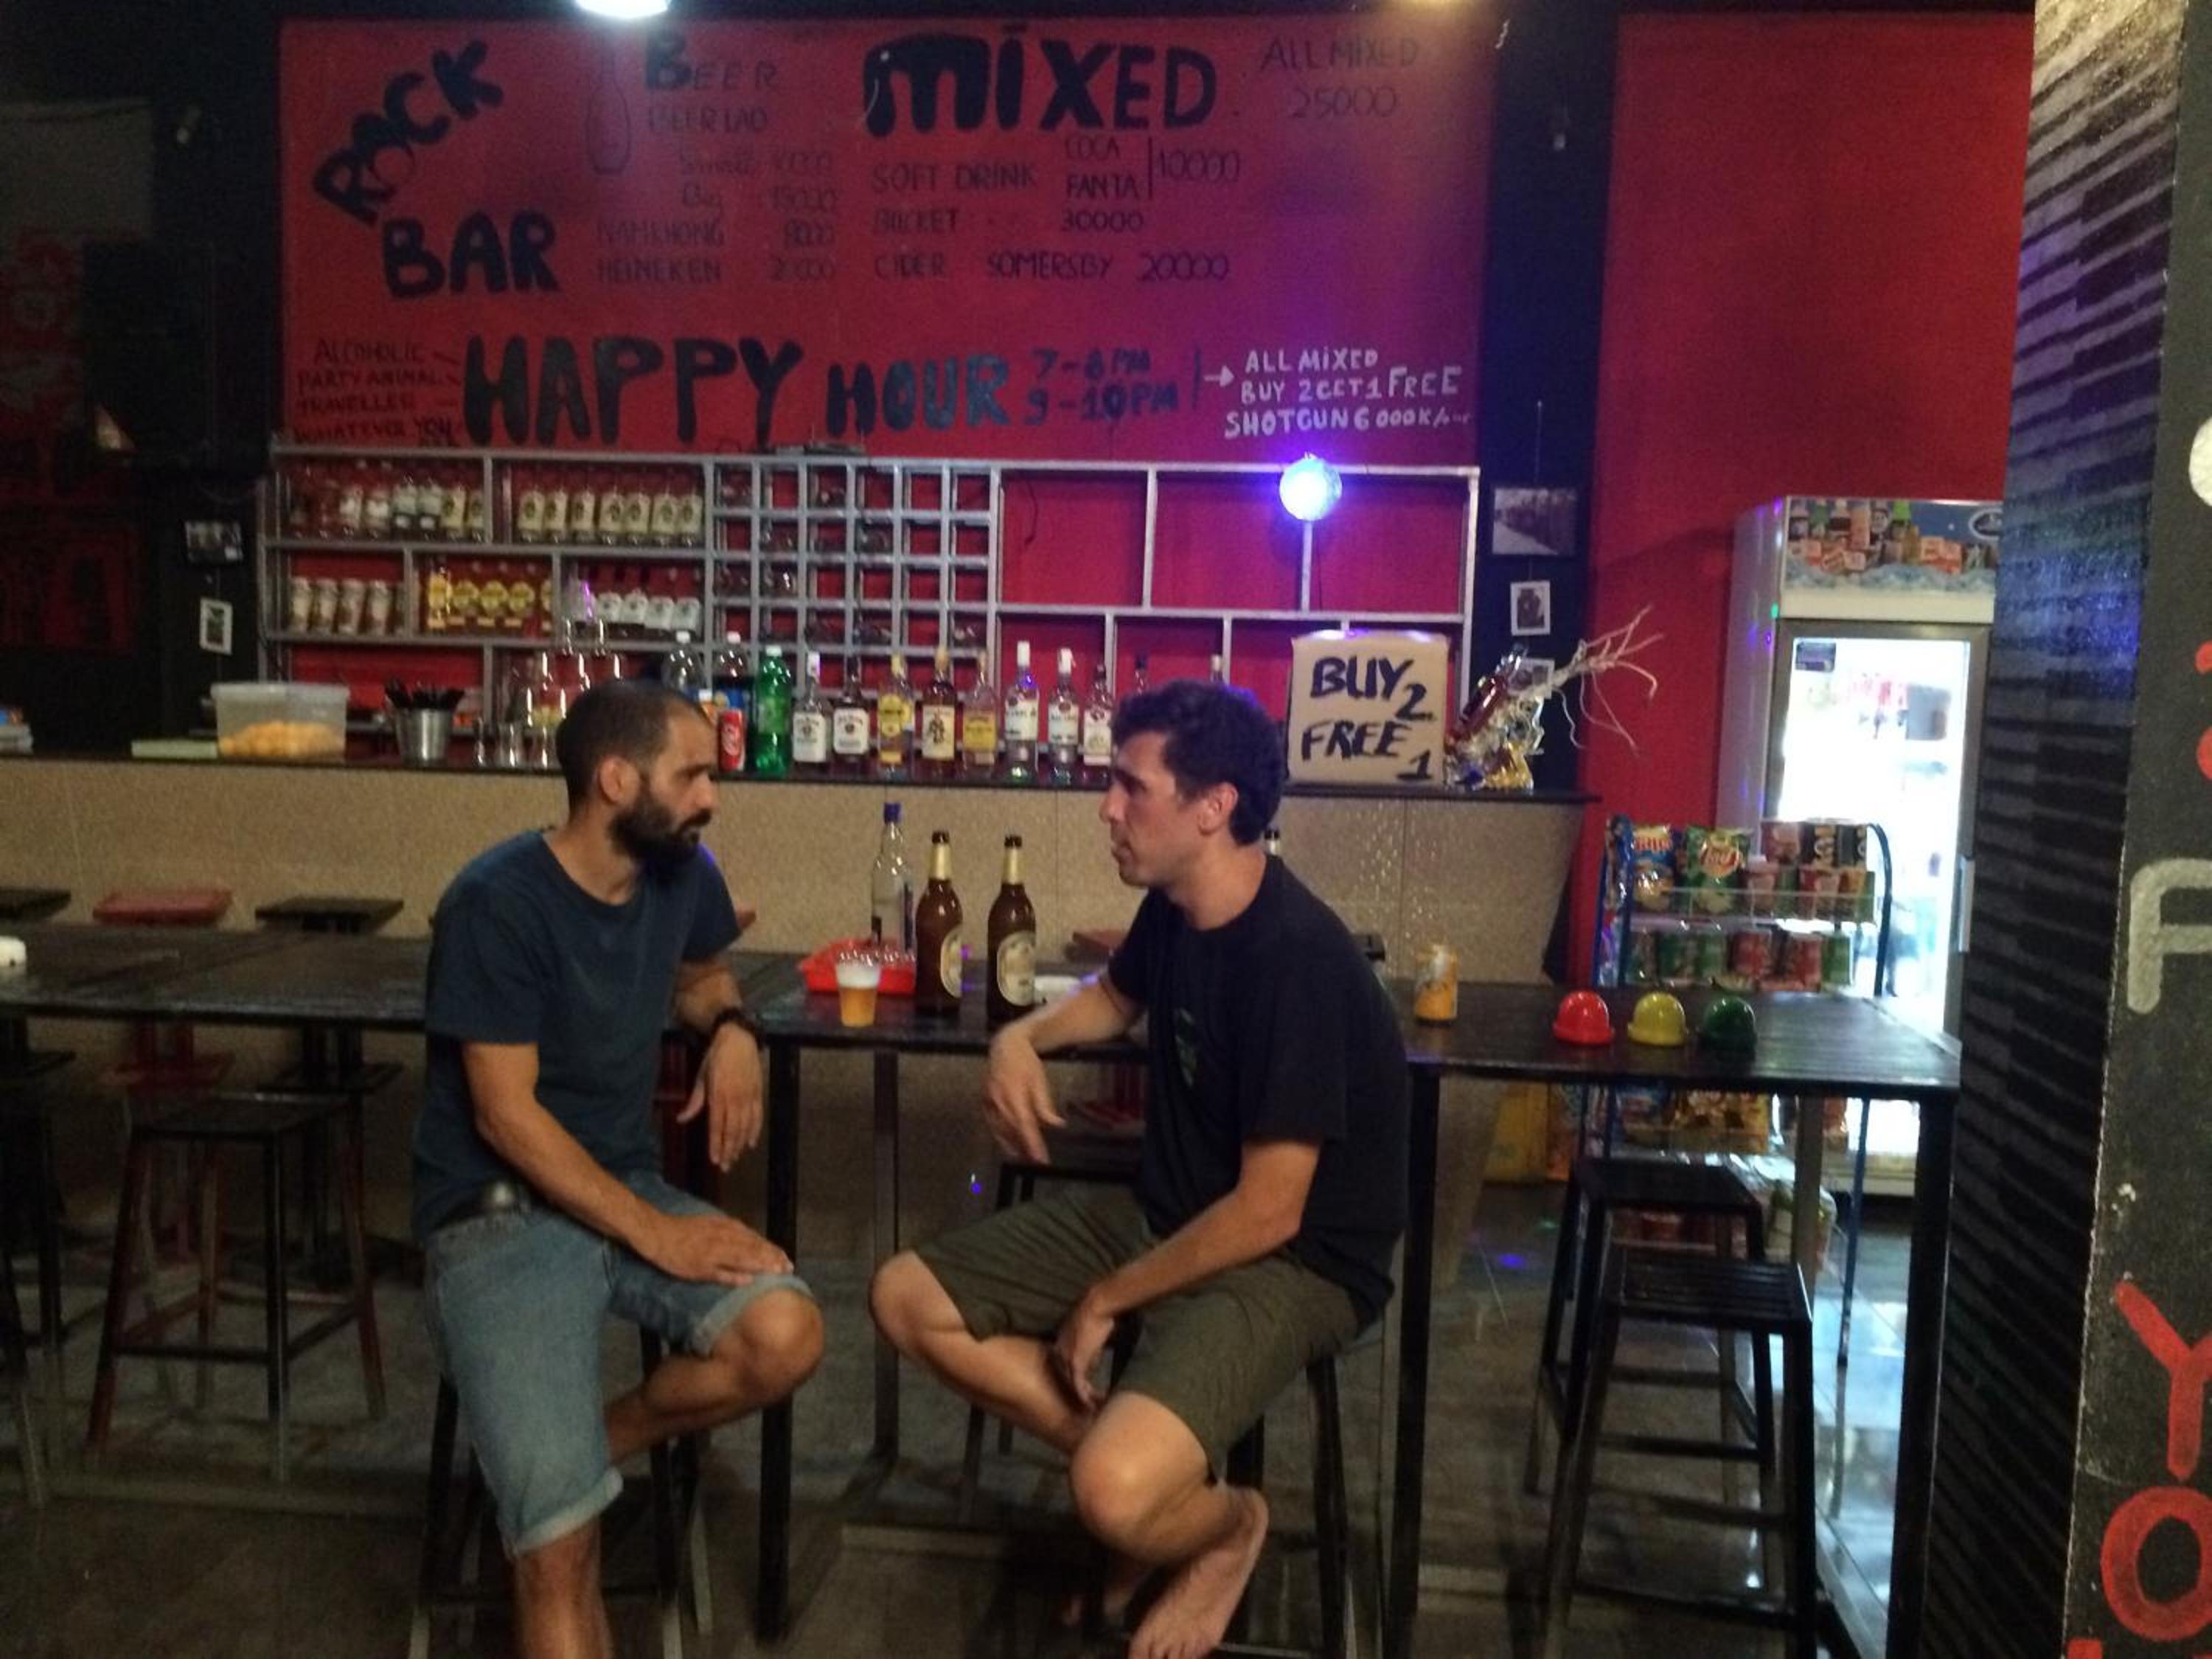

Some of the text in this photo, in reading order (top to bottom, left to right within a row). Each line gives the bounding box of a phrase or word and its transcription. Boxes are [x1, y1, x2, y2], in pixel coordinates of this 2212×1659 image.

[863, 24, 1219, 139] MIXED
[1288, 84, 1398, 118] 25000
[313, 37, 507, 230] ROCK
[872, 161, 1036, 192] SOFT DRINK
[1158, 148, 1242, 184] 10000
[1066, 174, 1139, 199] FANTA
[383, 202, 565, 302] BAR
[987, 250, 1114, 282] SOMERSBY
[1138, 251, 1231, 283] 20000
[598, 258, 721, 283] HEINEKEN
[1245, 345, 1379, 374] ALL MIXED
[465, 333, 1015, 453] HAPPY HOUR
[1241, 380, 1285, 405] BUY
[1298, 378, 1313, 403] 2
[1387, 364, 1464, 399] FREE
[1223, 407, 1349, 440] SHOTGUN
[1310, 653, 1439, 723] BUY 2
[1301, 717, 1433, 782] FREE 1
